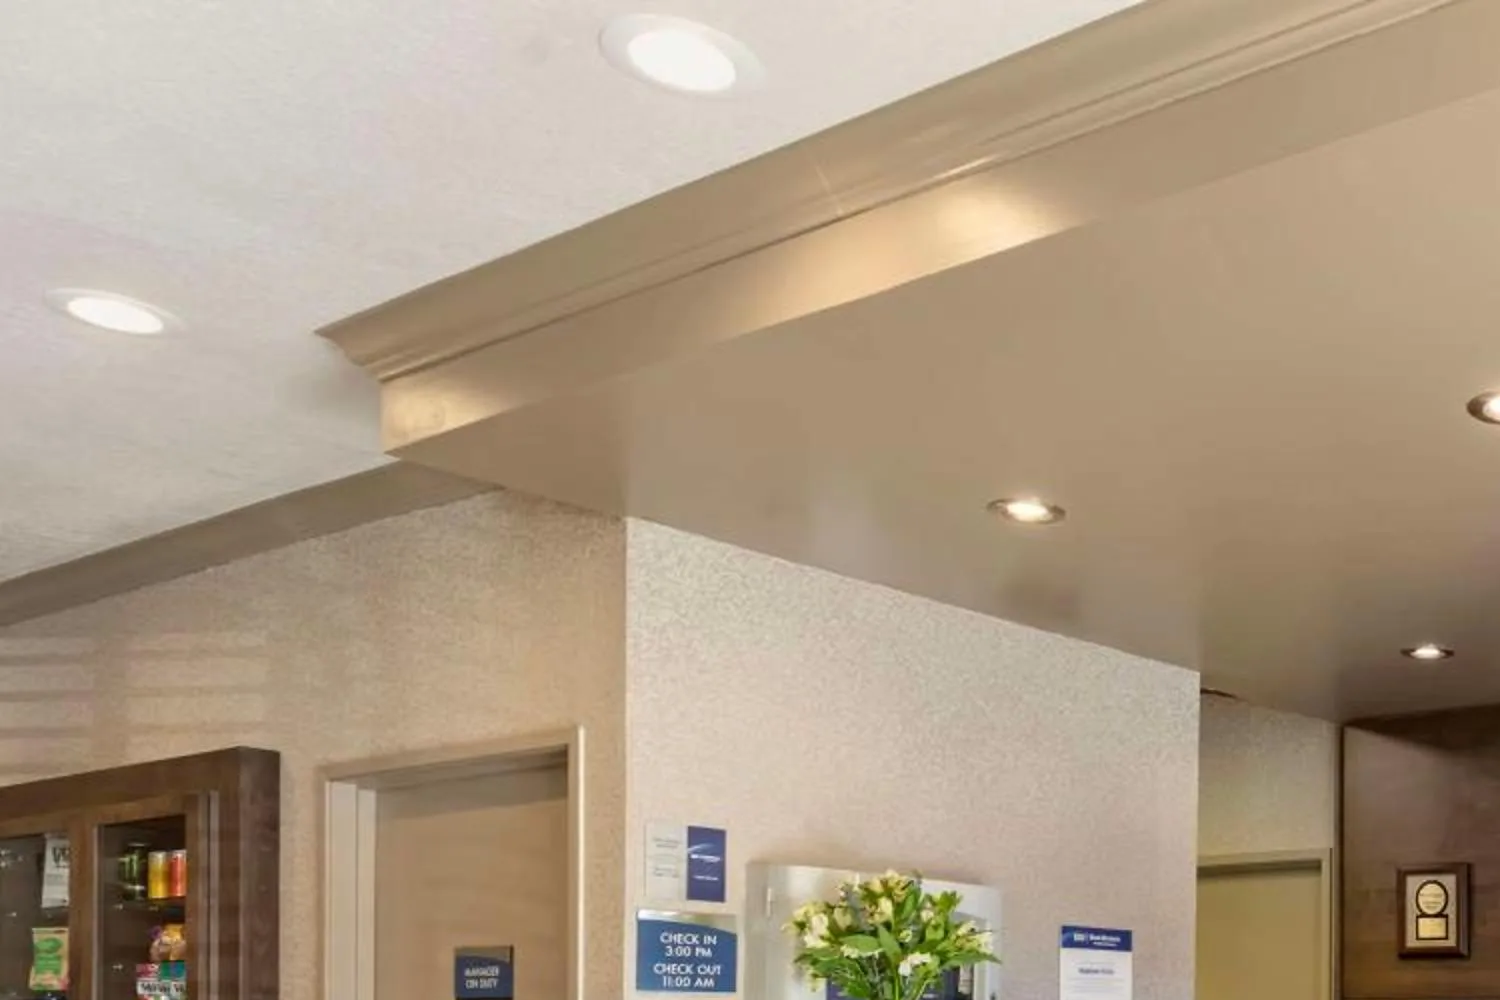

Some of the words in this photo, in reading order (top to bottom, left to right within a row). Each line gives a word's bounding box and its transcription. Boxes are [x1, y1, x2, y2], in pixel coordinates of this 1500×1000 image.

[660, 932, 700, 945] CHECK
[703, 935, 717, 946] IN
[664, 946, 691, 957] 3:00
[695, 947, 712, 958] PM
[653, 963, 693, 975] CHECK
[697, 964, 722, 976] OUT
[662, 976, 691, 987] 11:00
[694, 977, 715, 988] AM
